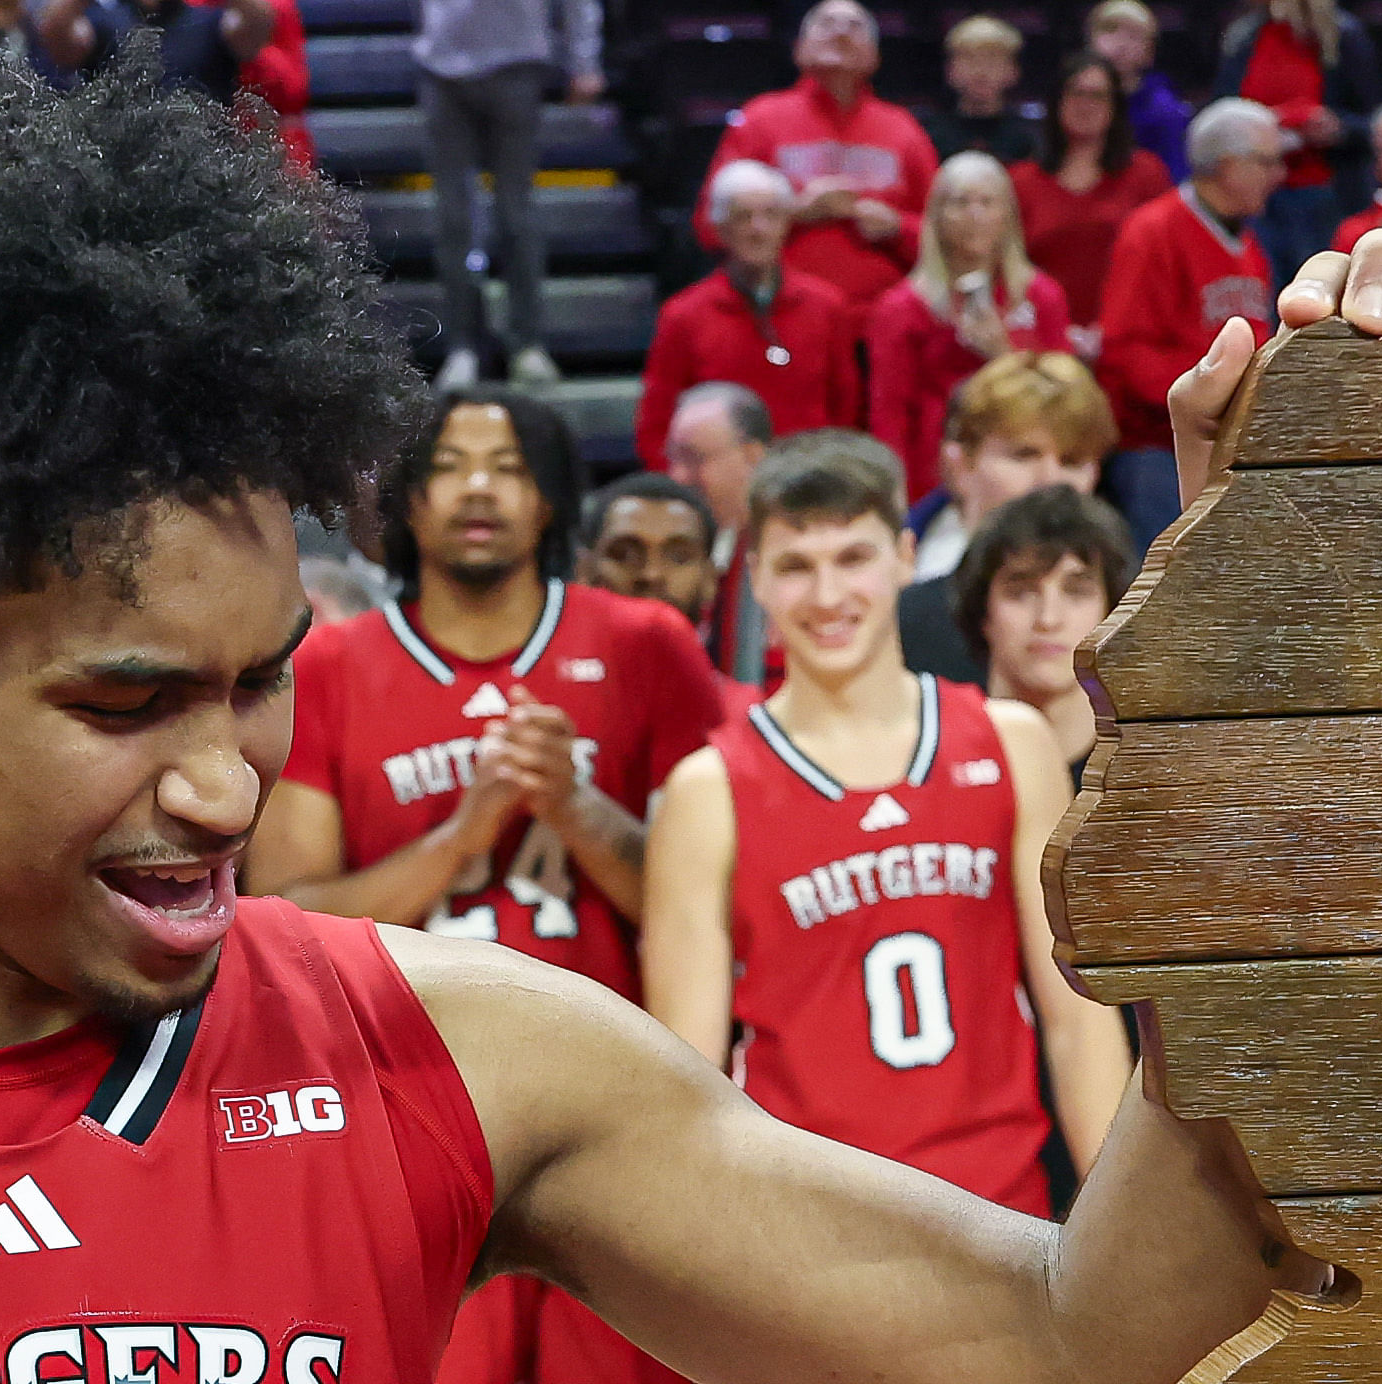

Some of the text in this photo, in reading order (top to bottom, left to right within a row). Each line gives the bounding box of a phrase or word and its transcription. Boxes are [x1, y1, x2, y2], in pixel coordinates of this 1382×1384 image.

[382, 736, 599, 805] RUTS
[781, 843, 1000, 929] RUTGERS
[863, 930, 956, 1070] 0
